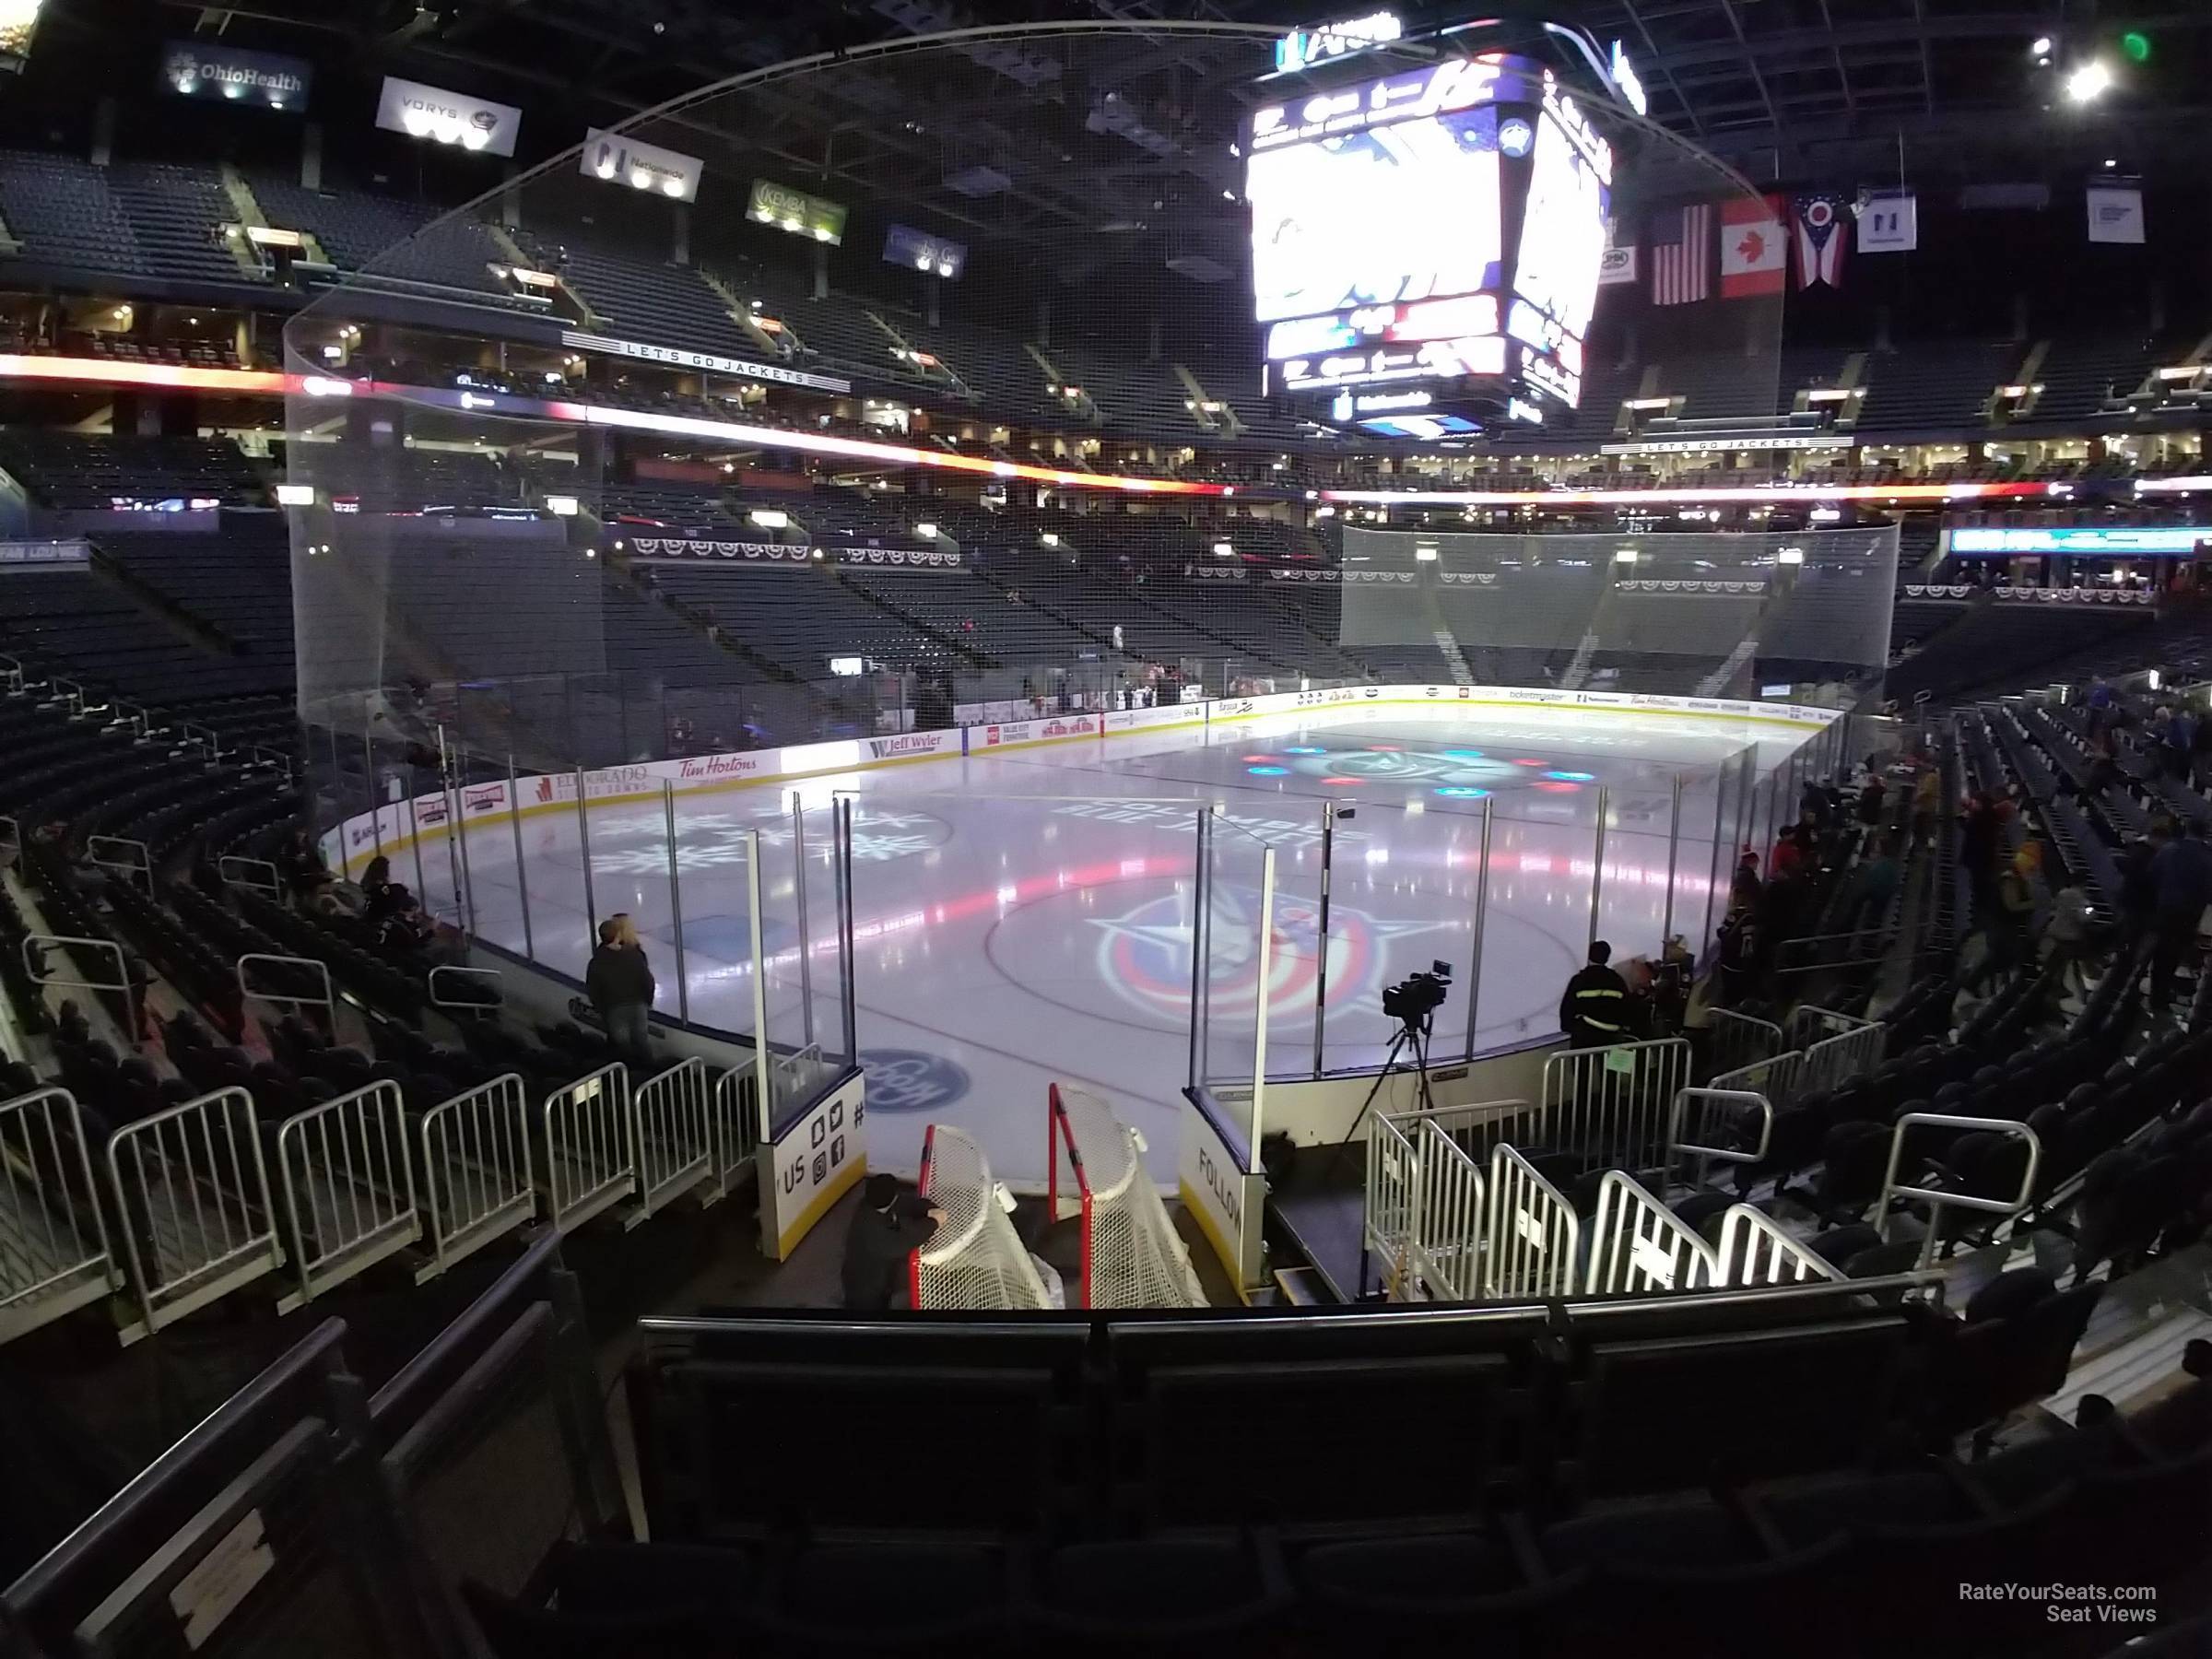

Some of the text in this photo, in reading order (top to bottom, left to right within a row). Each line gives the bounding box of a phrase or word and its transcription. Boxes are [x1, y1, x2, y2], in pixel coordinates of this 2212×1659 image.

[201, 64, 302, 91] OhioHealth
[402, 96, 457, 119] VORYS
[630, 156, 685, 181] Nationwide
[627, 344, 804, 383] LET'S GO JACKETS
[1647, 439, 1804, 453] LET'S GO JACKETS
[890, 736, 910, 751] Jeff
[678, 756, 757, 778] Tim Hortons
[784, 1155, 806, 1195] US
